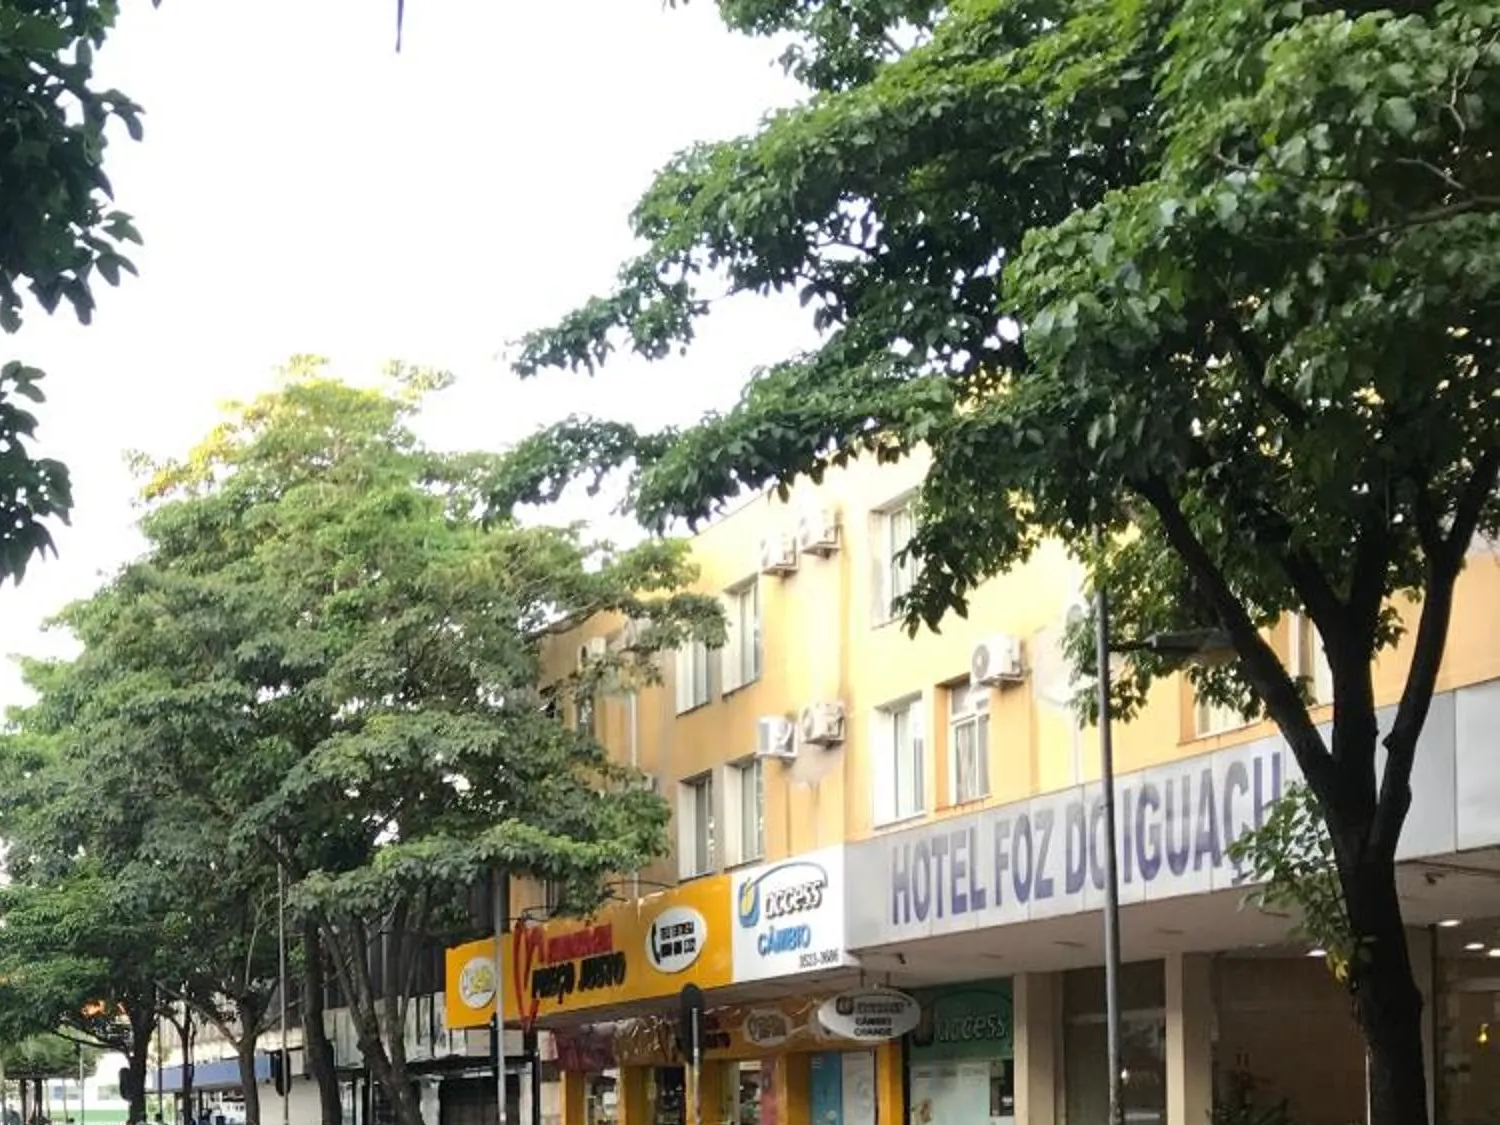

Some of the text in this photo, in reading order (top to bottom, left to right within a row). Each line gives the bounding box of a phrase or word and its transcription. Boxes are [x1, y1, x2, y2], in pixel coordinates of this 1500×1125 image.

[891, 826, 986, 925] HOTEL
[994, 808, 1054, 907] FOZ
[1065, 799, 1107, 895] DO
[765, 879, 823, 920] access
[757, 924, 811, 957] CÂMBIO
[531, 961, 575, 1004] PREÇO
[578, 950, 627, 992] JUSTO
